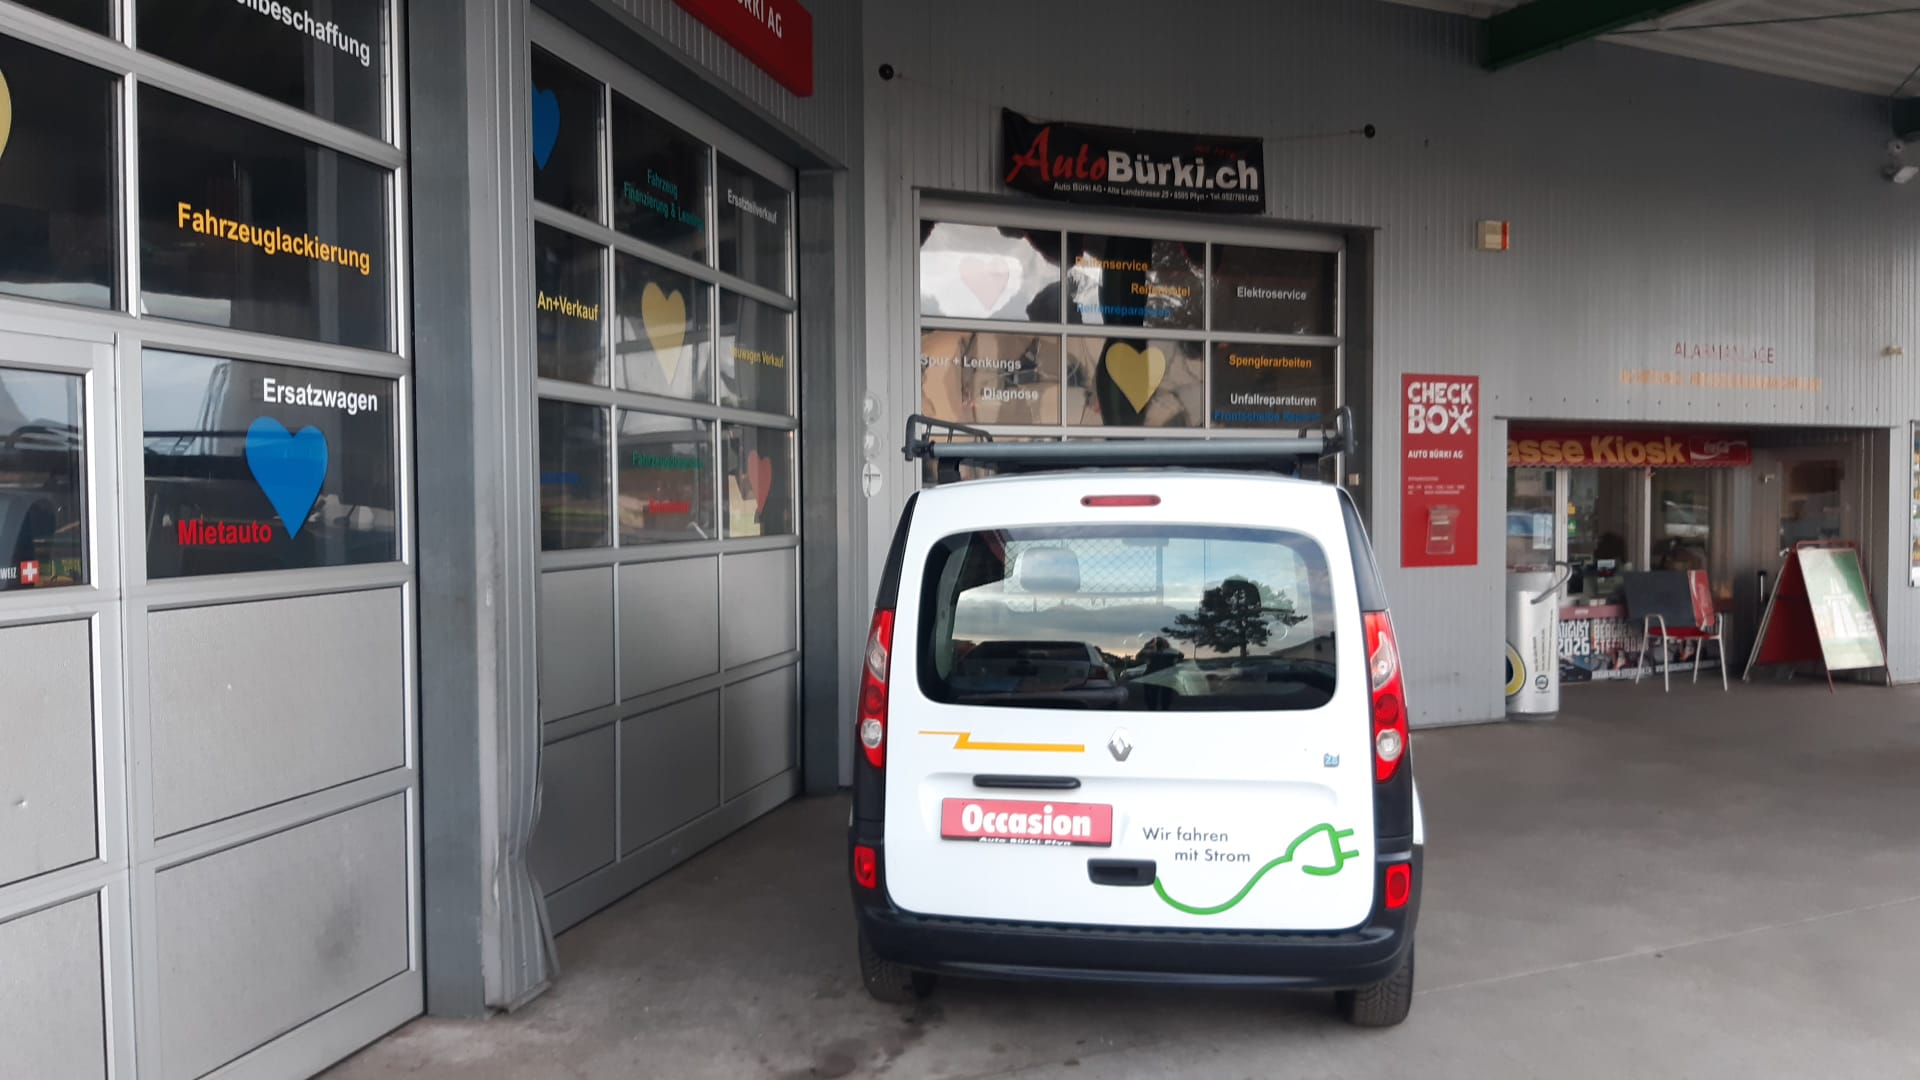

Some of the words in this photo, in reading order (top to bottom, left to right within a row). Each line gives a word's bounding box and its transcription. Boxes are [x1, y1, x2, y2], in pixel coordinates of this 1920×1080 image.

[767, 6, 782, 39] AG
[1053, 181, 1071, 192] Auto
[1073, 183, 1091, 192] Bürki
[1093, 184, 1102, 193] AG
[178, 202, 371, 275] Fahrzeuglackierung
[1236, 286, 1307, 301] Elektroservice
[537, 290, 599, 321] An+Verkauf
[963, 356, 1022, 372] Lenkungs
[1229, 354, 1312, 369] Spenglerarbeiten
[263, 378, 378, 415] Ersatzwagen
[983, 387, 1039, 402] Diagnose
[1230, 393, 1317, 408] Unfallreparaturen
[1407, 382, 1473, 404] CHECK
[1407, 404, 1473, 435] BOX
[1407, 450, 1428, 459] AUTO
[1429, 449, 1452, 459] BÜRKI
[1453, 450, 1464, 459] AG
[1591, 435, 1686, 465] Kiosk
[177, 519, 272, 546] Mietauto
[961, 804, 1092, 837] Occasion
[978, 836, 1007, 844] Auto
[1010, 837, 1041, 846] Bürki
[1142, 826, 1171, 841] Wir
[1177, 825, 1228, 842] fahren
[1175, 848, 1198, 862] mit
[1205, 848, 1251, 863] Strom
